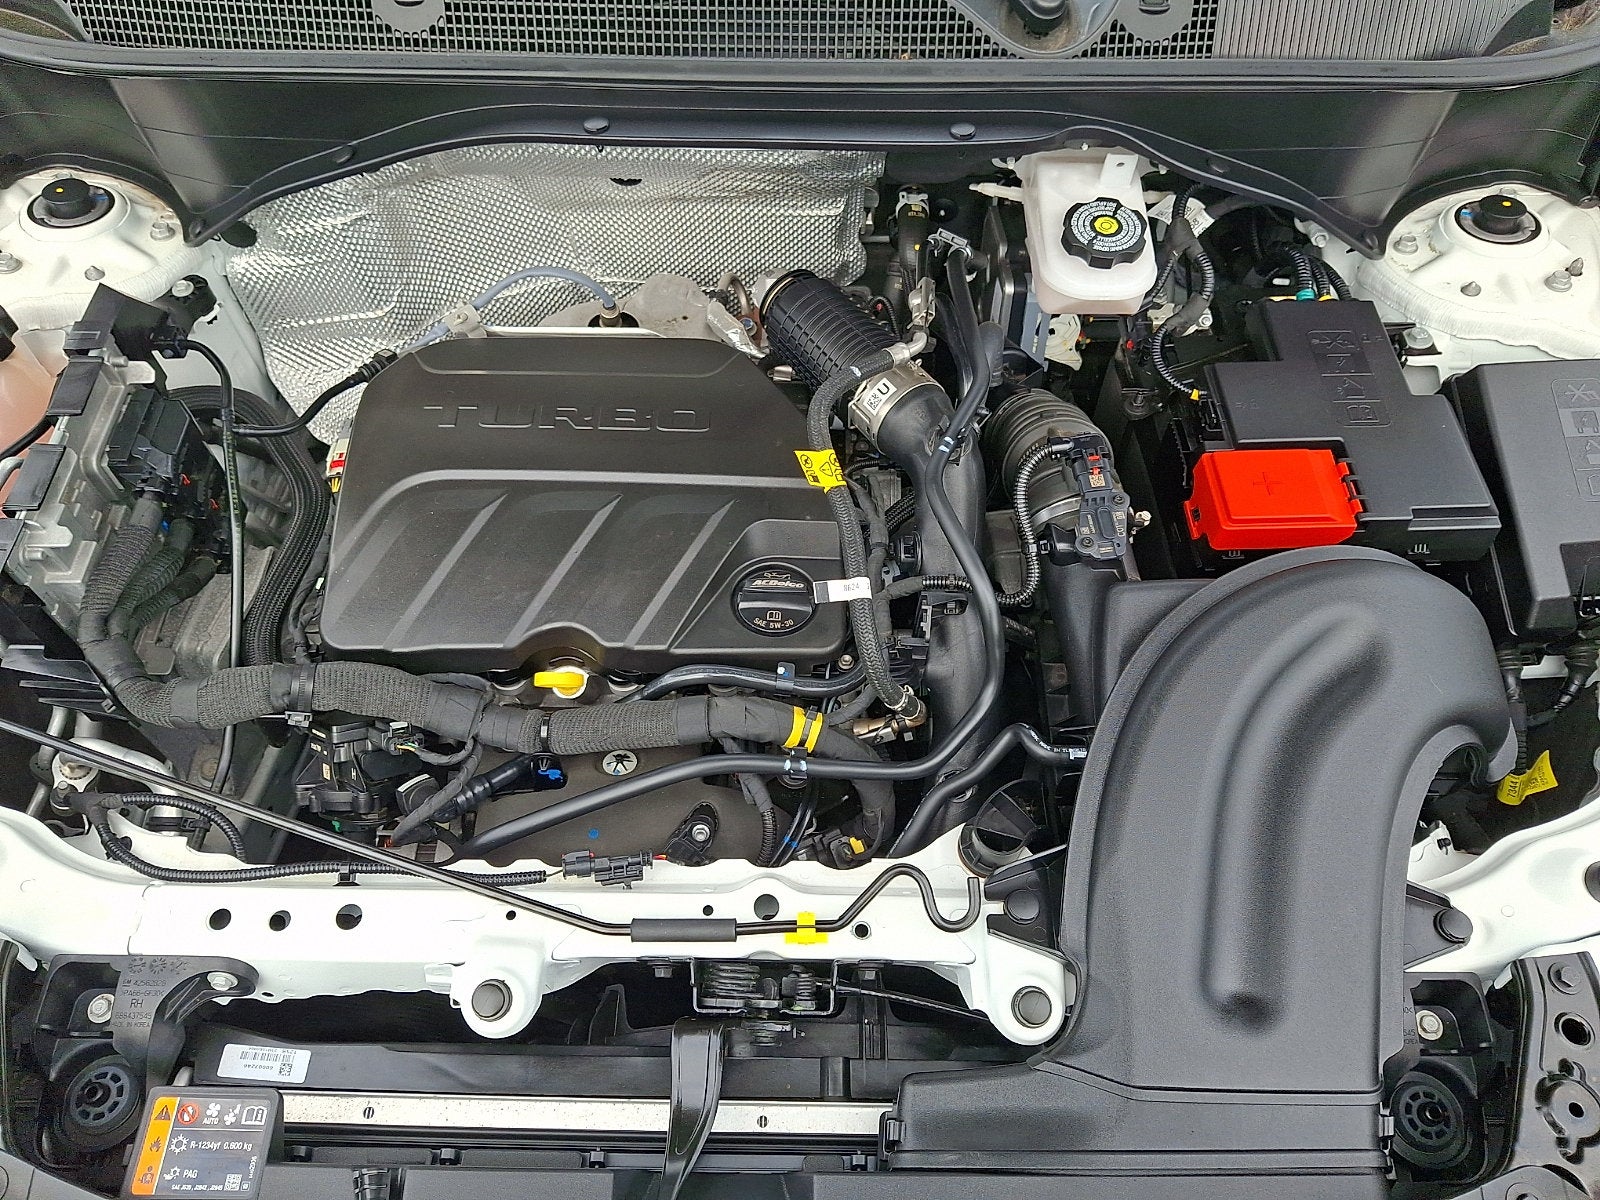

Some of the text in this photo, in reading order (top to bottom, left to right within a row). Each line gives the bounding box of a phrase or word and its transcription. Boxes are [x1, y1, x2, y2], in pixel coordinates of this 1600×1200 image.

[877, 382, 890, 395] U
[423, 403, 711, 433] TURBO
[751, 579, 805, 588] ACDelco
[753, 617, 794, 629] SAE 5W-30
[1506, 780, 1519, 798] 7344
[130, 998, 144, 1008] RH
[202, 1117, 220, 1125] AUTO
[190, 1140, 253, 1152] R-1234yf 0.600 kg
[183, 1169, 198, 1179] PAG
